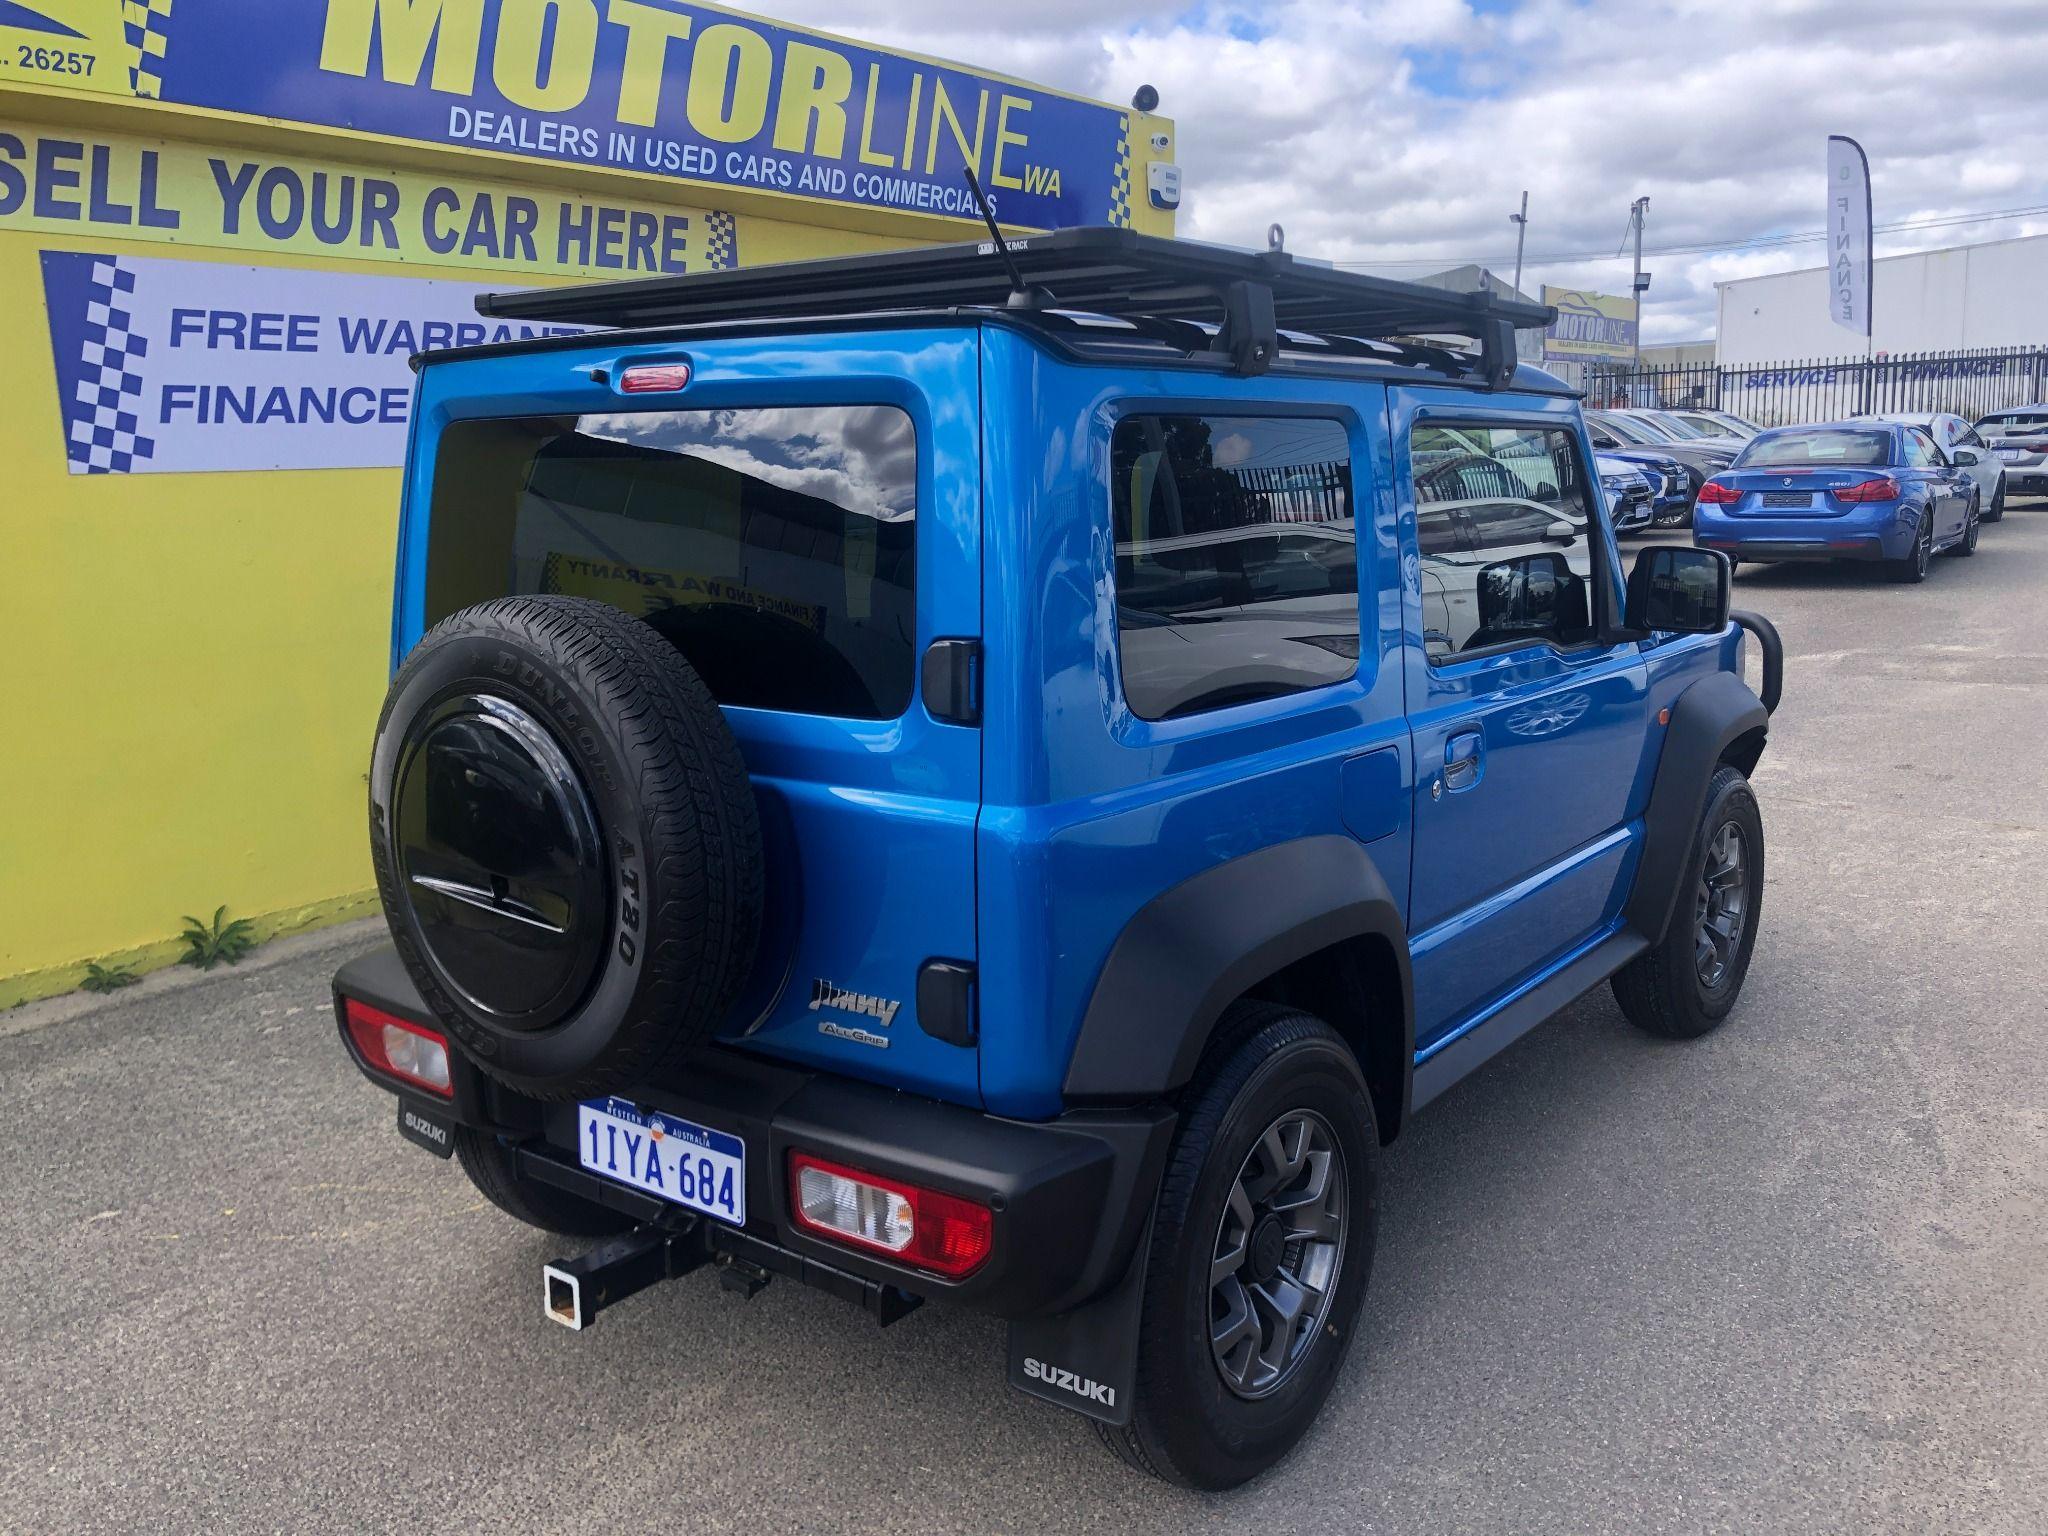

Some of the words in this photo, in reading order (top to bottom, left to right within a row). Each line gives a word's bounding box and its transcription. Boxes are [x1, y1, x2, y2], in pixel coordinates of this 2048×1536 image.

[18, 45, 96, 77] 26257
[319, 0, 1033, 190] MOTORLINE
[1024, 164, 1061, 198] WA
[448, 105, 599, 158] DEALERS
[607, 132, 636, 163] IN
[644, 138, 718, 175] USED
[724, 151, 793, 188] CARS
[798, 164, 847, 195] AND
[853, 172, 997, 217] COMMERCIALS
[0, 132, 180, 229] SELL
[208, 159, 401, 250] YOUR
[422, 186, 538, 262] CAR
[556, 202, 689, 274] HERE
[168, 307, 320, 353] FREE
[338, 316, 586, 356] WARRA
[1555, 313, 1625, 344] MOTORLINE
[1745, 367, 1838, 388] SERVICE
[159, 384, 408, 424] FINANCE
[405, 1111, 447, 1145] SUZUKI
[607, 1105, 642, 1125] WESTERN
[672, 1128, 710, 1148] AUSTRALIA
[1023, 1357, 1115, 1407] SUZUKI
